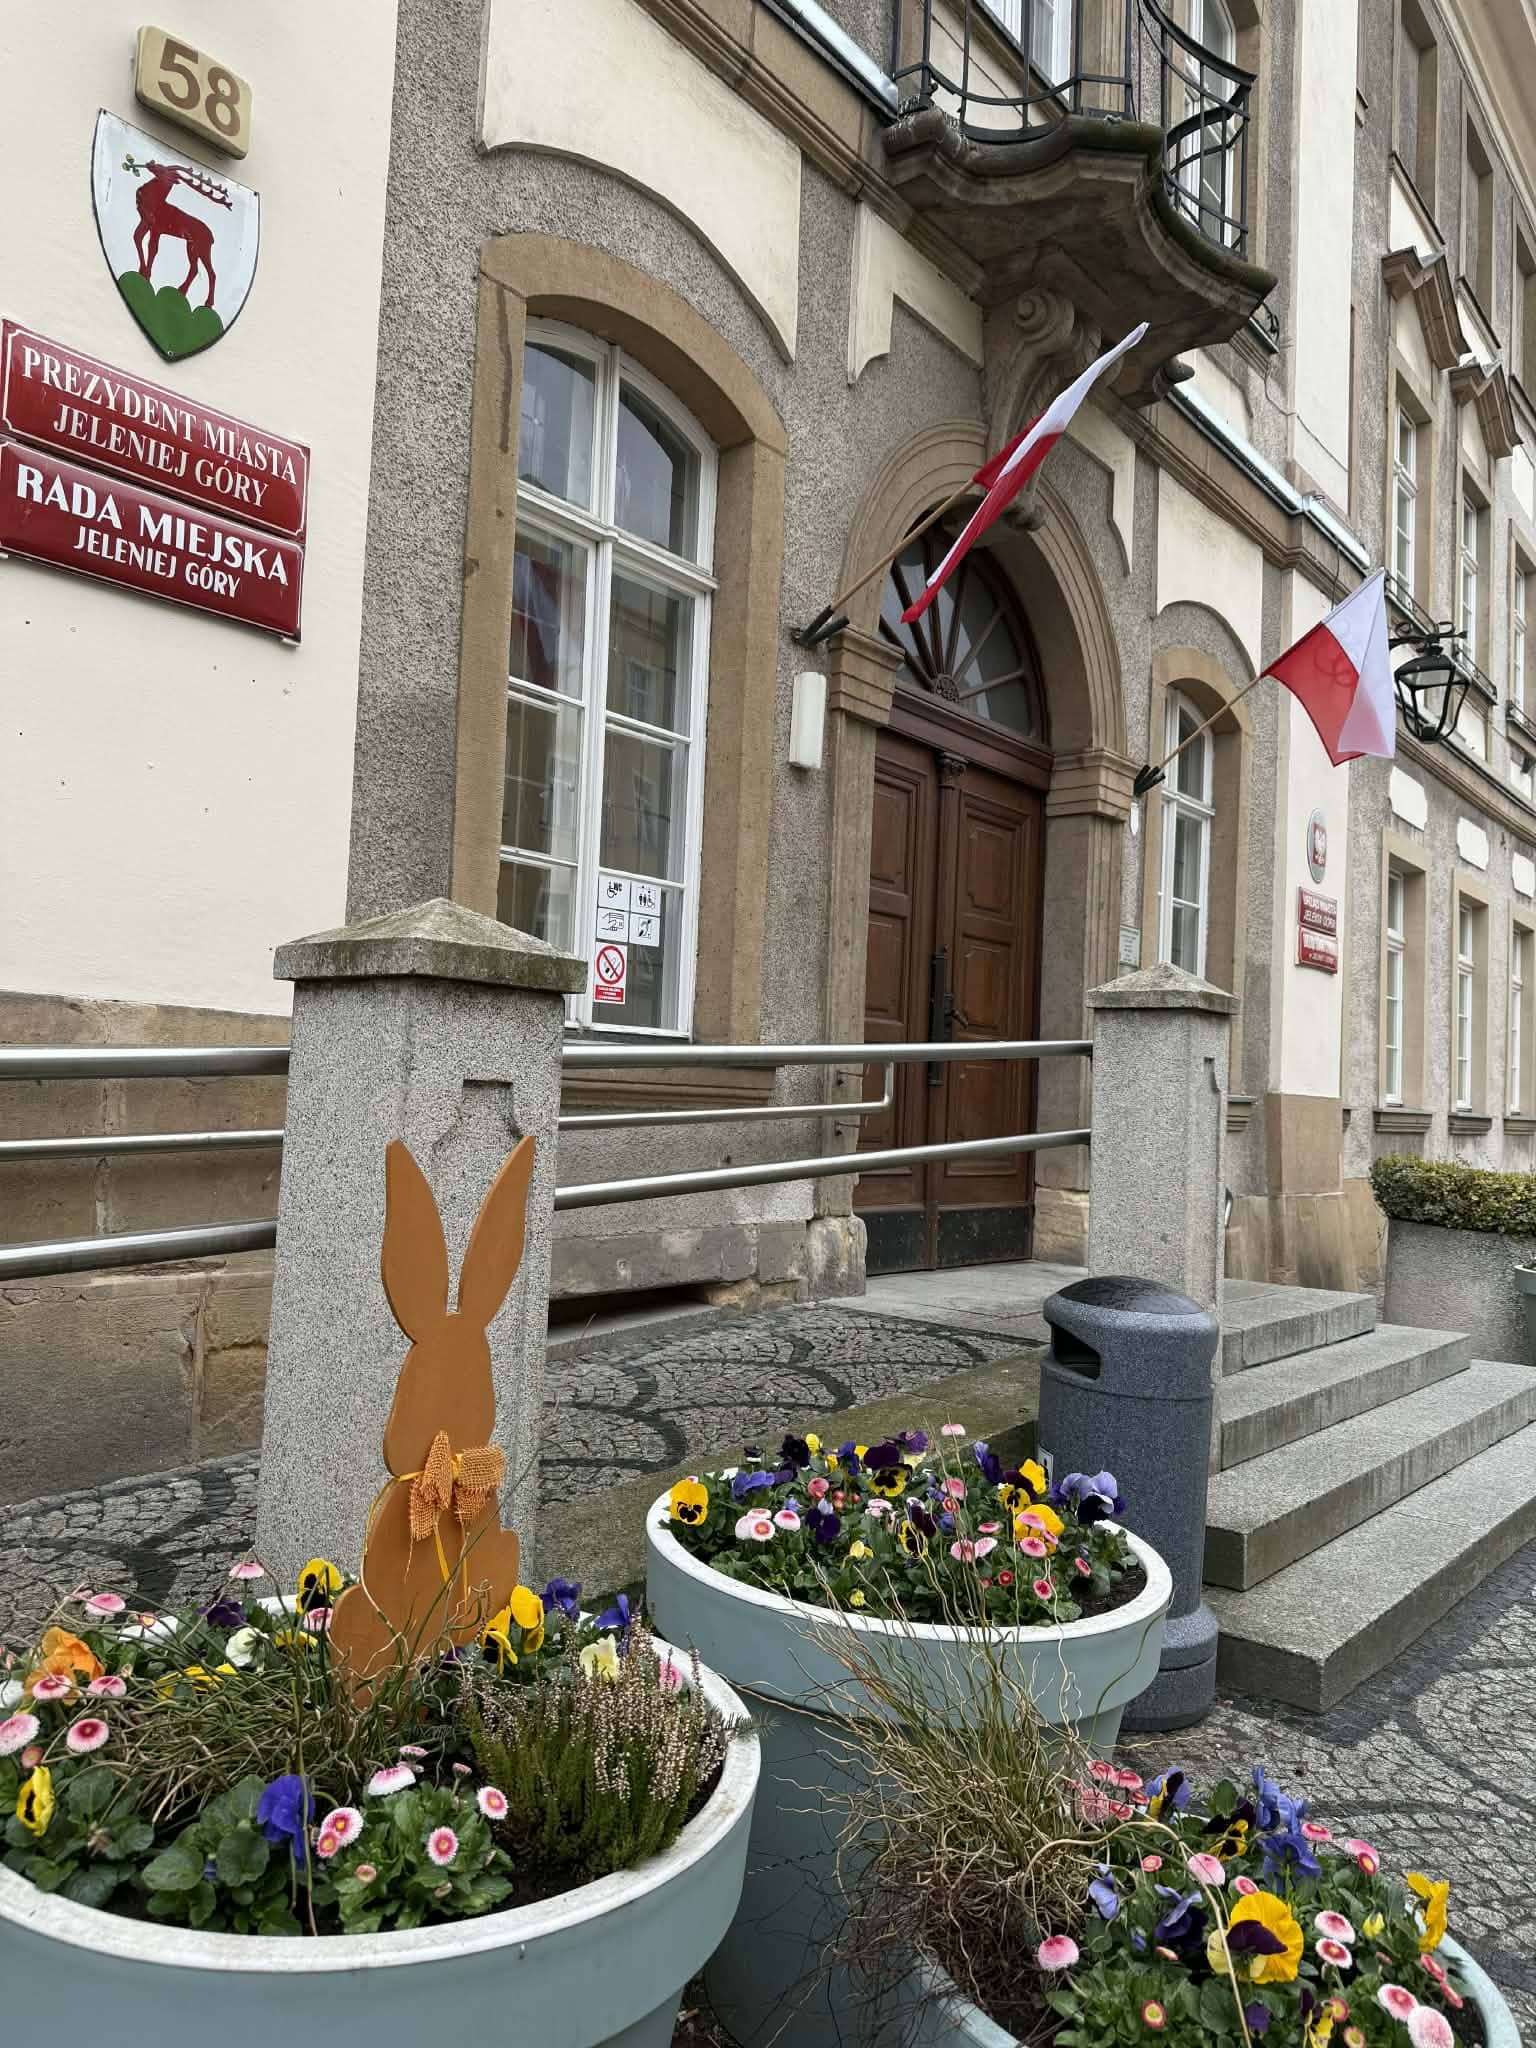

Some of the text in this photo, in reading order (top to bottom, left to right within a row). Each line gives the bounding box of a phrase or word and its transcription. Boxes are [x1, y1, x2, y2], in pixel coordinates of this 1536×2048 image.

[157, 37, 242, 138] 58
[22, 345, 297, 485] PREZYDENT MIASTA
[53, 403, 269, 508] JELENIEJ GÓRY
[17, 463, 288, 586] RADA MIEJSKA
[74, 526, 240, 598] JELENIEJ GÓRY
